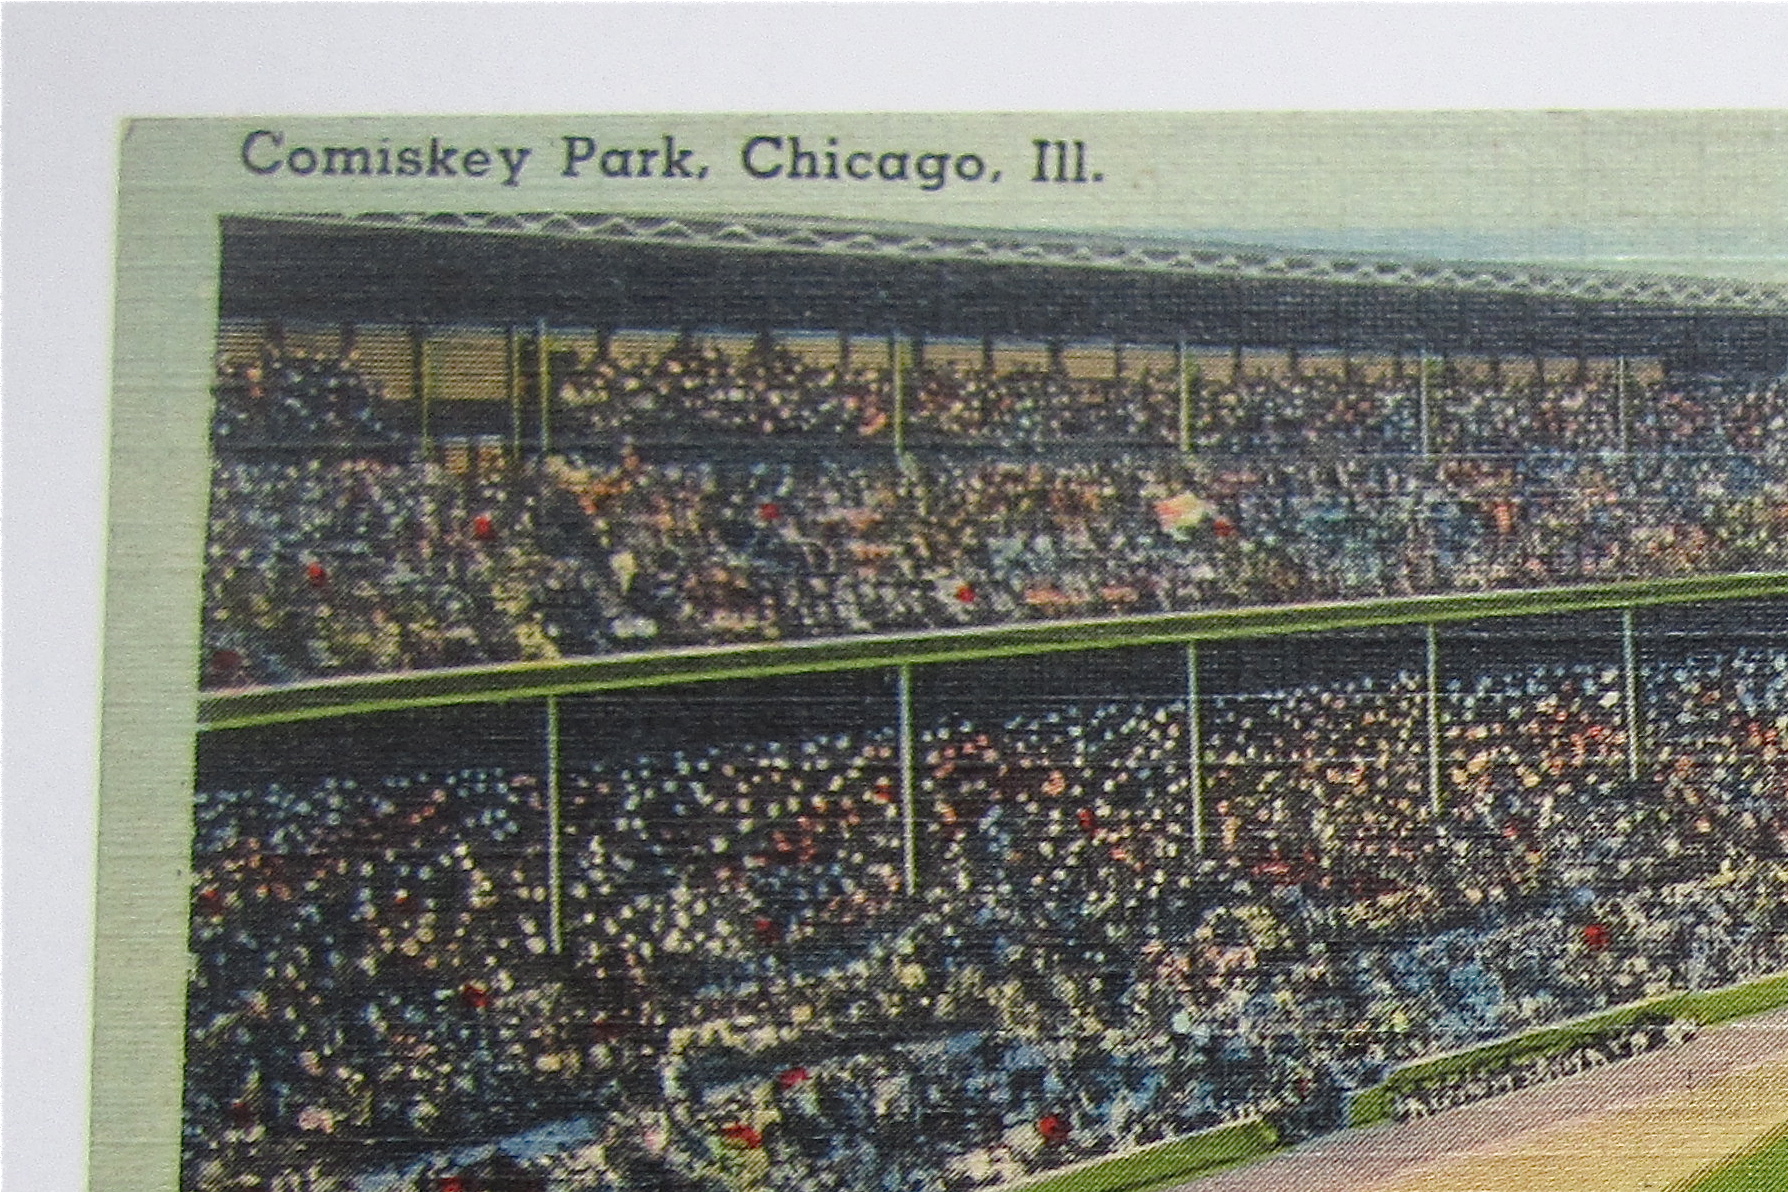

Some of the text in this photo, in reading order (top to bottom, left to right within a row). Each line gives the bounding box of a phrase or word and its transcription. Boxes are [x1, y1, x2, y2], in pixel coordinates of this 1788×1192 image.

[240, 129, 1104, 192] Comiskey Park, Chicago, Ill.
